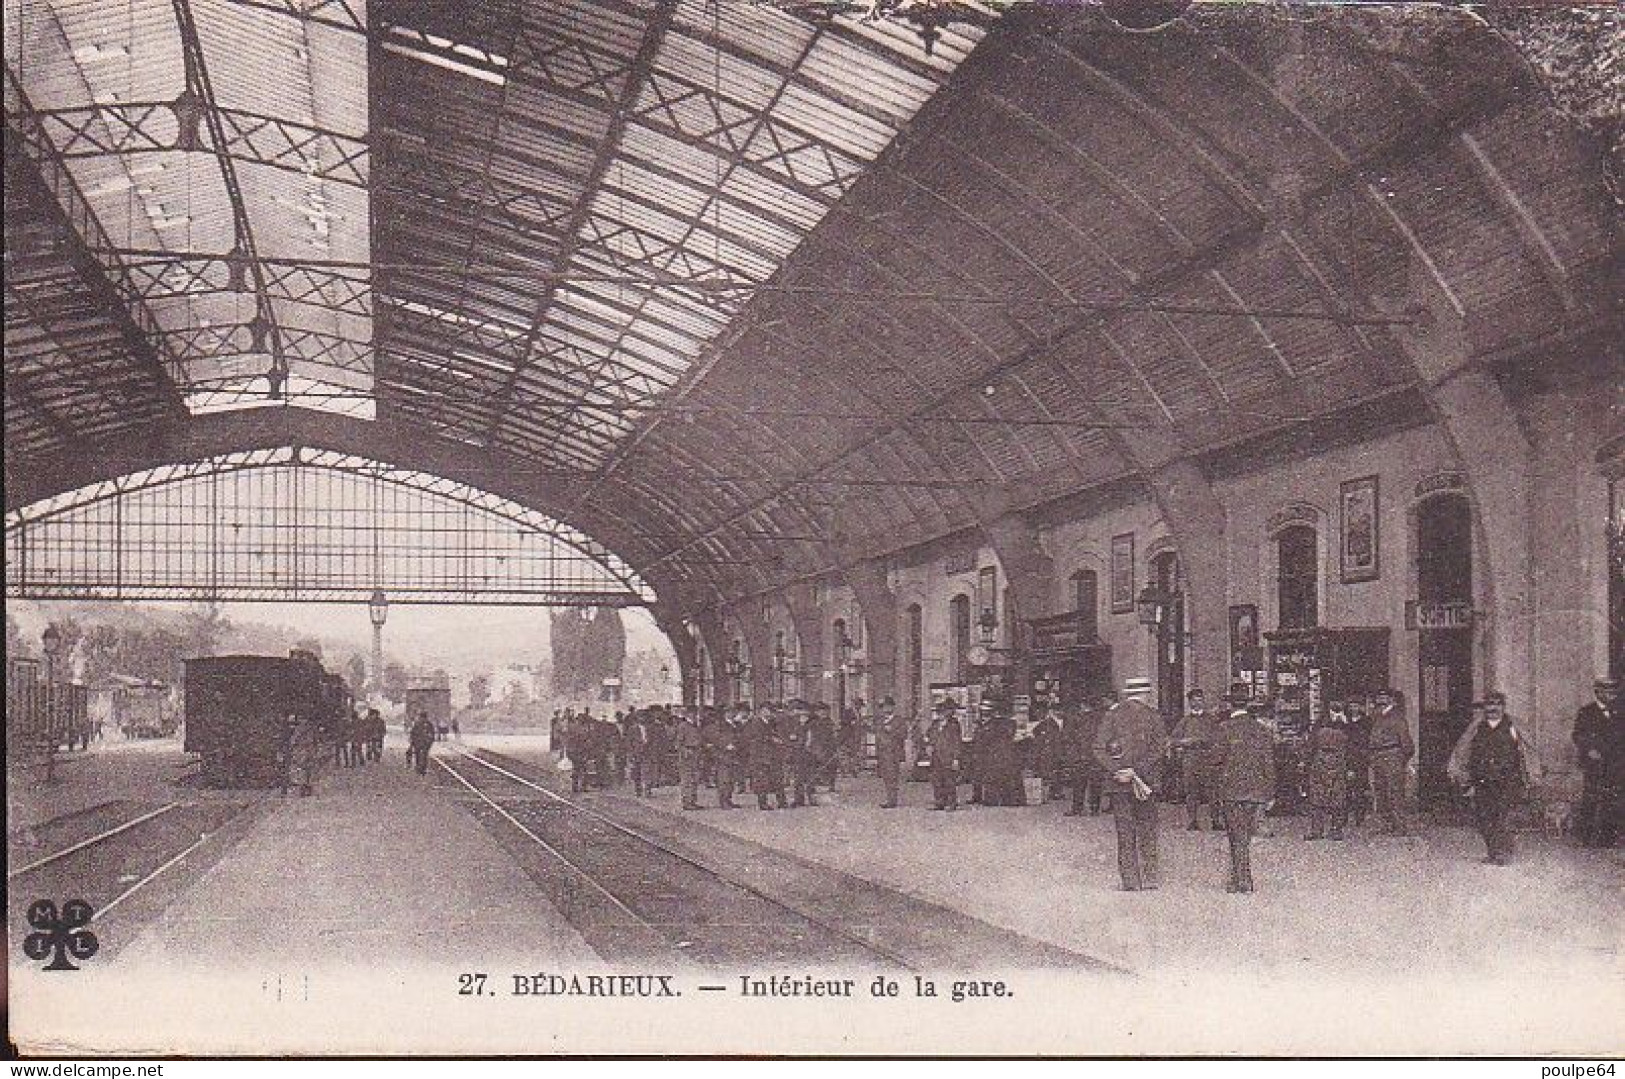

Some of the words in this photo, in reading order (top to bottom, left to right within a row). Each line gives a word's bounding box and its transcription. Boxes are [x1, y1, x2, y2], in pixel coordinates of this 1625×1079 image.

[458, 973, 496, 997] 27.
[511, 972, 682, 997] BÉDARIEUX.
[738, 975, 856, 998] Intérieur
[870, 975, 899, 998] de
[915, 975, 939, 998] la
[951, 980, 1014, 1003] gare.
